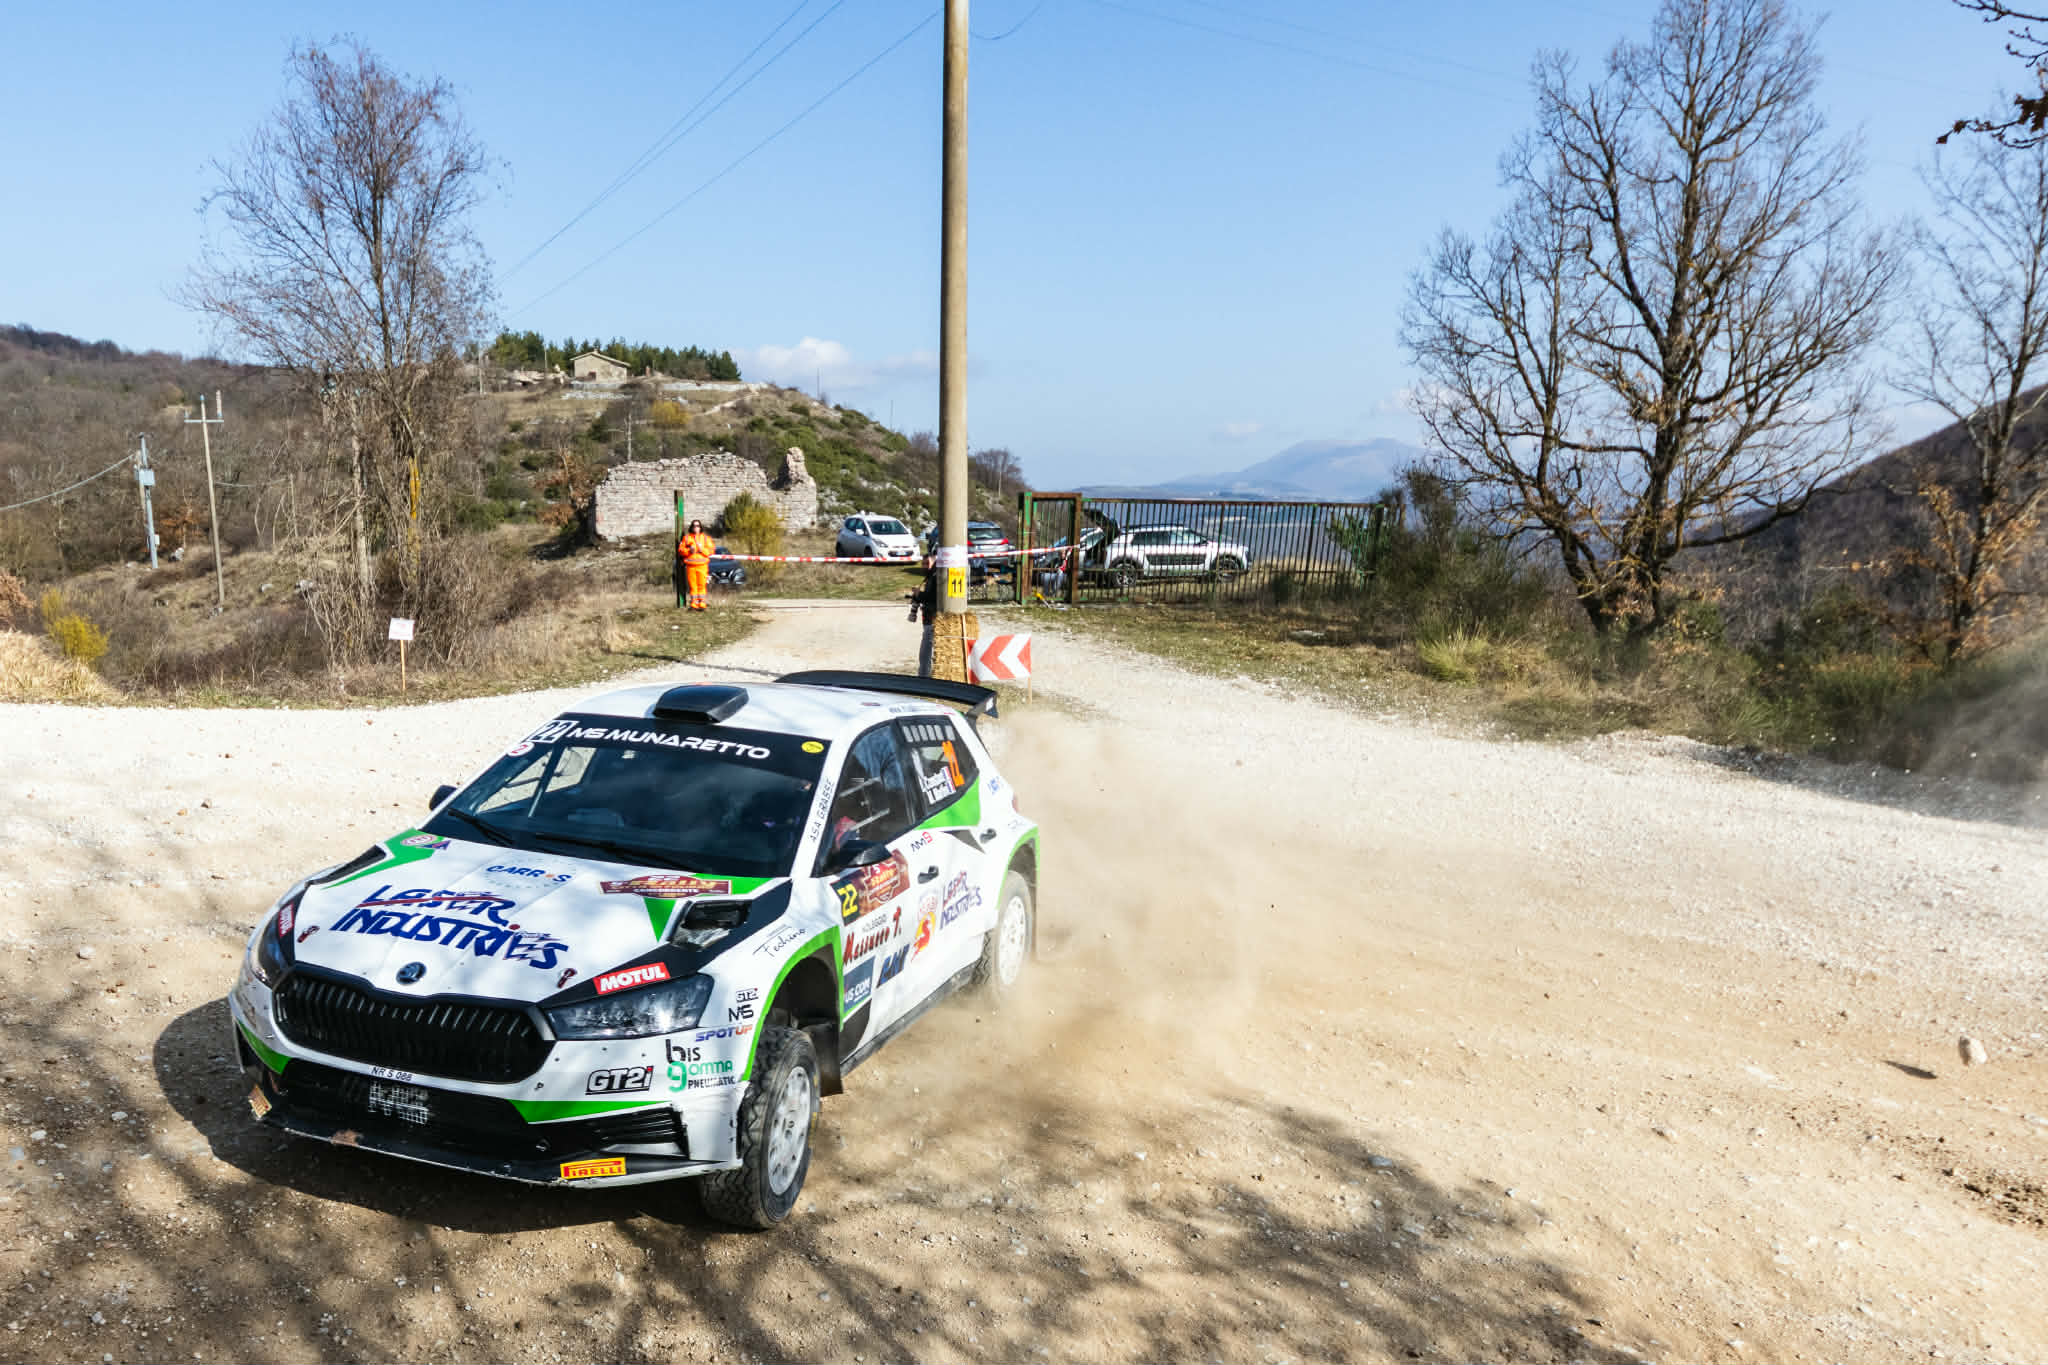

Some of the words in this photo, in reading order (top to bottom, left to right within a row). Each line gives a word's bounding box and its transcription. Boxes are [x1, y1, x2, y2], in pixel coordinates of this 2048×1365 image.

[602, 730, 770, 759] MUNARETTO
[837, 884, 858, 917] 22
[328, 906, 570, 970] INDUSTRIES
[600, 965, 666, 992] MOTUL
[696, 1024, 753, 1042] SPOTUP
[587, 1066, 654, 1092] GT2i
[563, 1161, 624, 1177] PIRELLI
